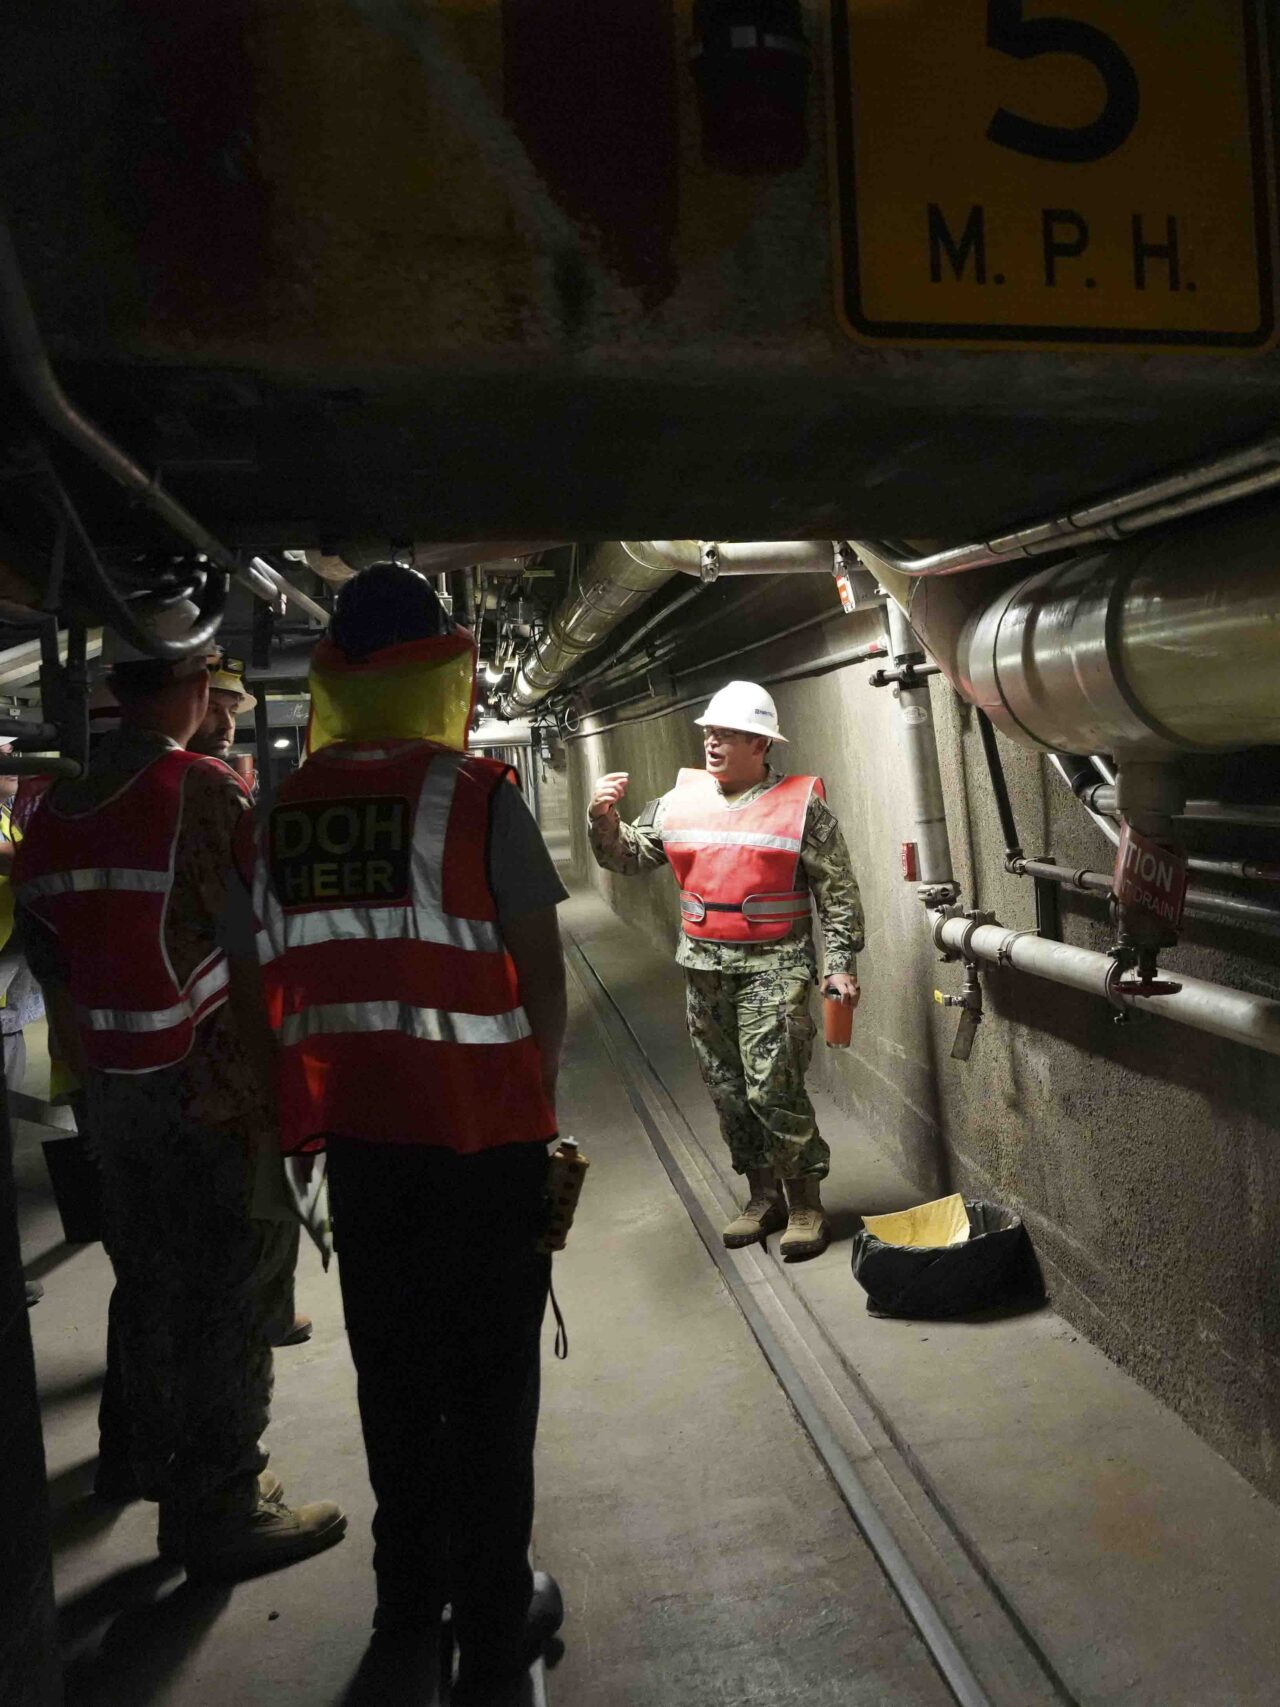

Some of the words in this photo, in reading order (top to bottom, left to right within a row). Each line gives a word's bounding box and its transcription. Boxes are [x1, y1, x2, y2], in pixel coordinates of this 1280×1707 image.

[987, 0, 1139, 163] 5
[276, 804, 404, 859] DOH
[285, 860, 395, 901] HEER
